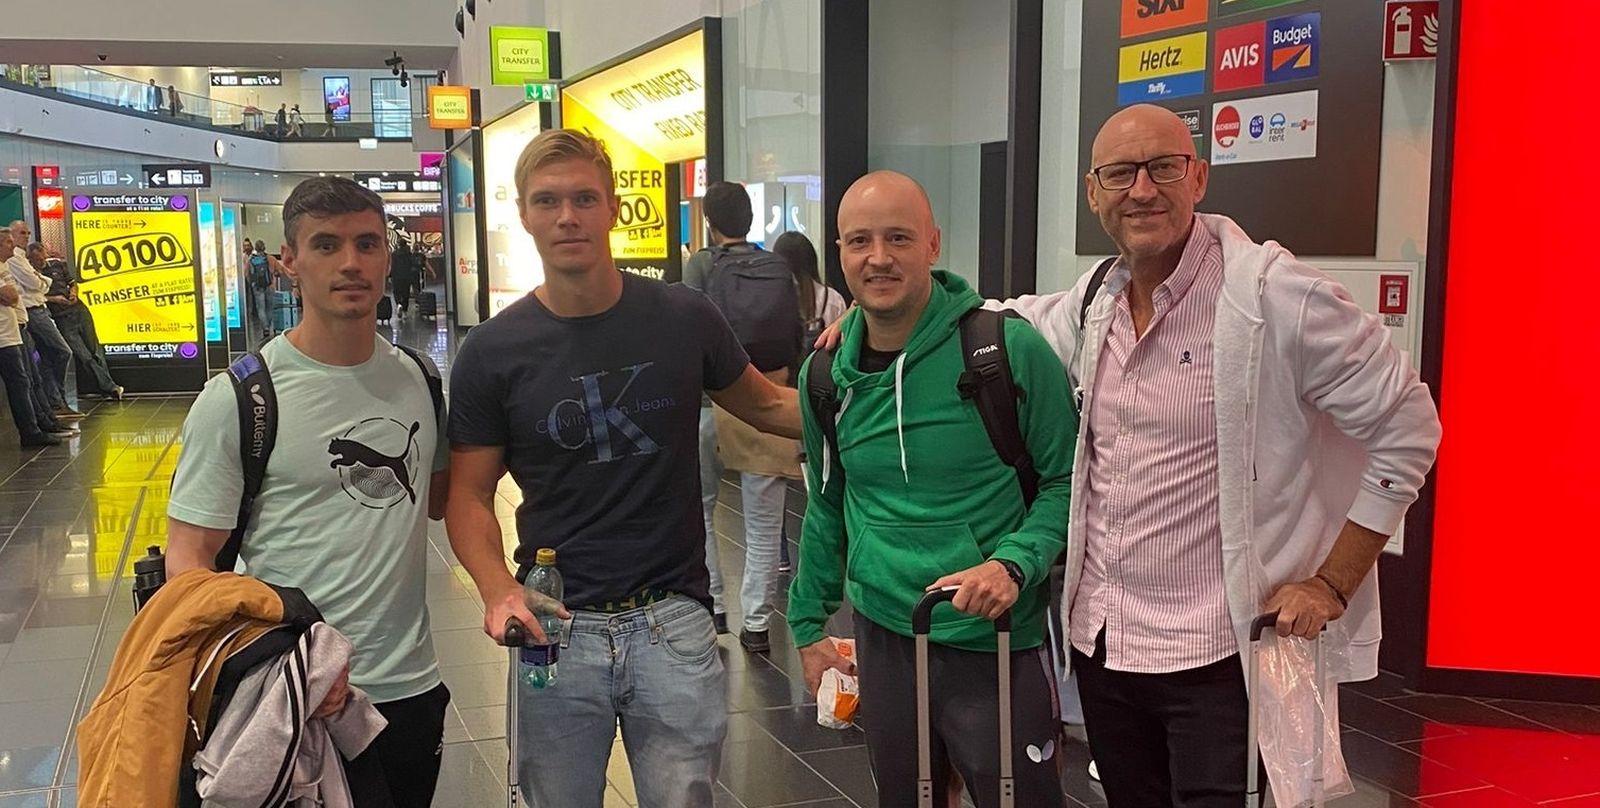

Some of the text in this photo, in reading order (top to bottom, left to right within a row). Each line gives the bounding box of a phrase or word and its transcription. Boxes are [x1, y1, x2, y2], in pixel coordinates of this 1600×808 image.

[1273, 24, 1312, 45] Budget
[501, 57, 541, 65] TRANSFER
[1139, 47, 1181, 71] Hertz
[1220, 44, 1259, 71] AVIS
[611, 68, 702, 111] CITY TRANSFER
[92, 195, 169, 206] transfer to city
[75, 220, 101, 229] HERE
[83, 236, 177, 275] 40100
[127, 323, 151, 333] HIER
[104, 343, 178, 353] transfer to city
[973, 344, 998, 357] STIGA
[535, 415, 586, 434] Clvin
